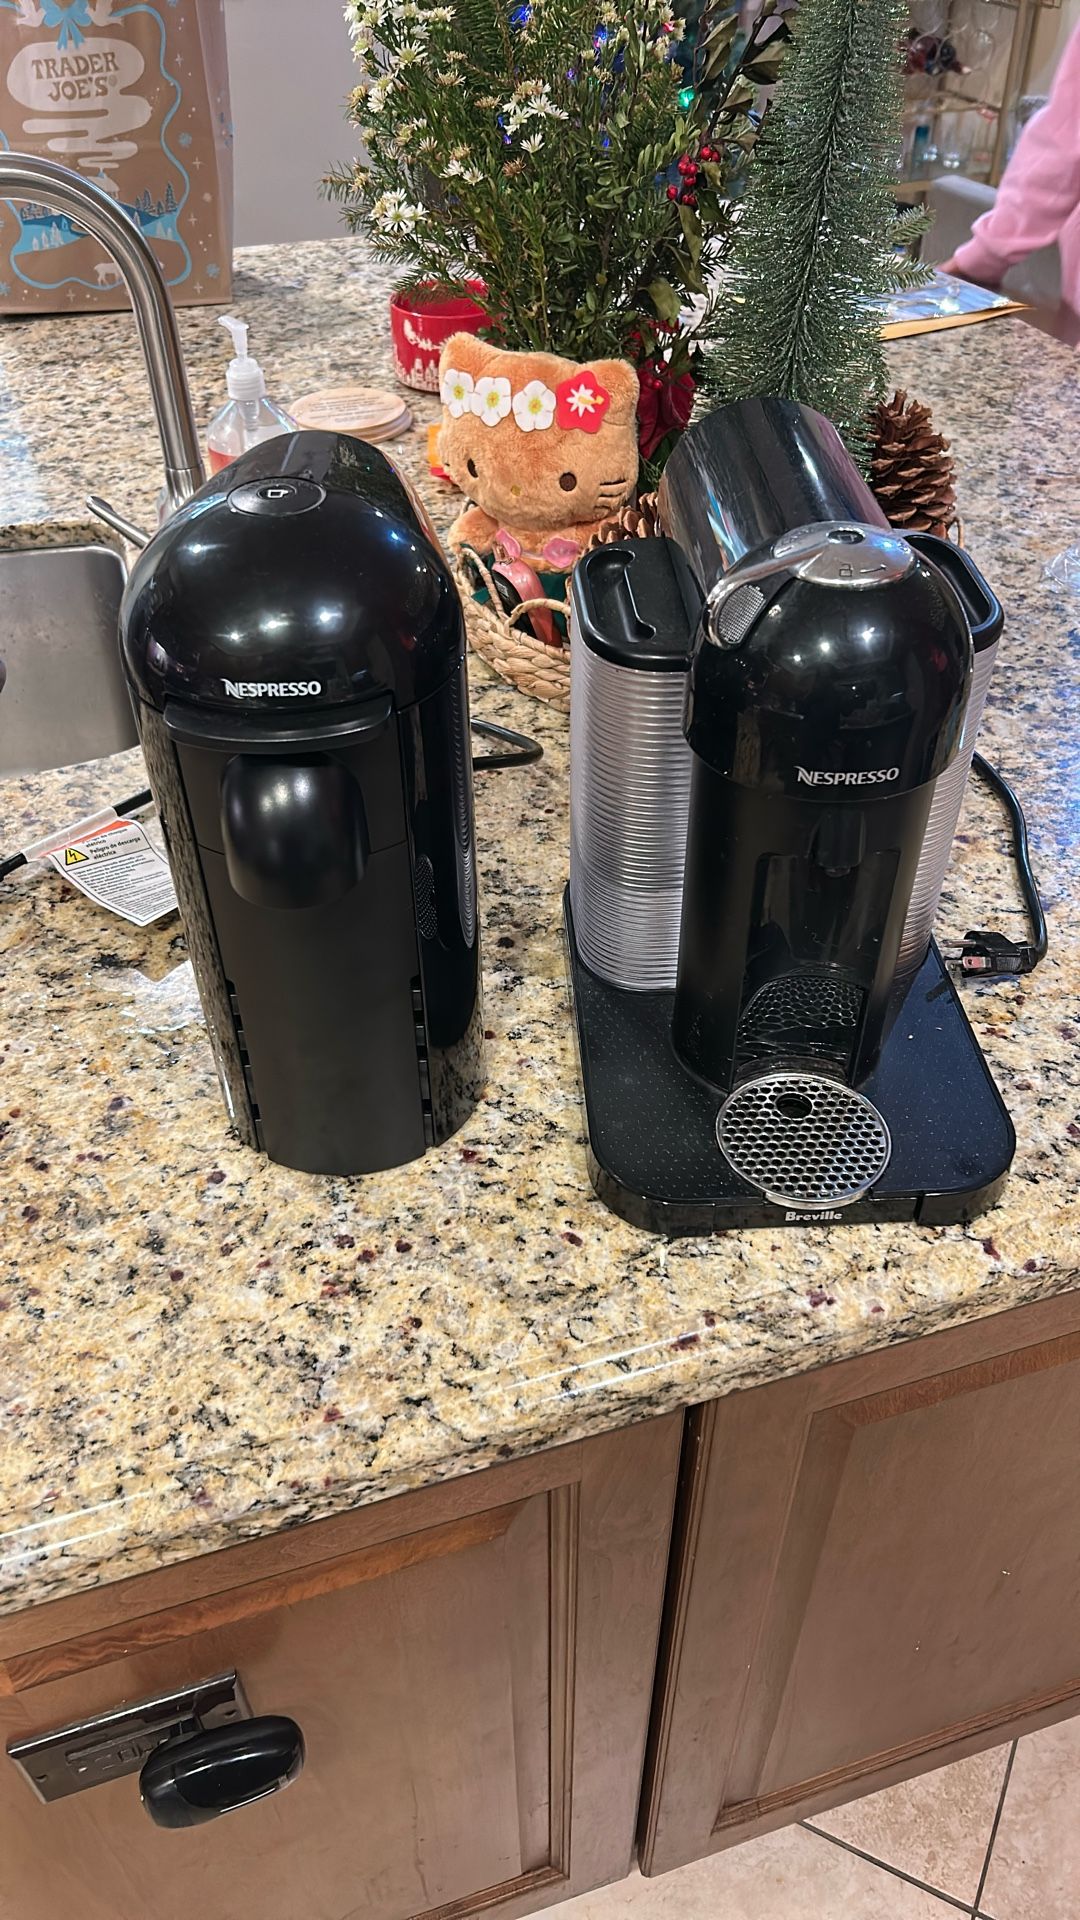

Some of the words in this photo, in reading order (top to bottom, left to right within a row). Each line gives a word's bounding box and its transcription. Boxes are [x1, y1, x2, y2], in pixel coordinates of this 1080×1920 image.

[32, 52, 119, 79] TRADER
[48, 77, 109, 102] JOE'S
[220, 678, 322, 699] NESPRESSO
[793, 765, 899, 786] NESPRESSO
[785, 1211, 842, 1221] Breville
